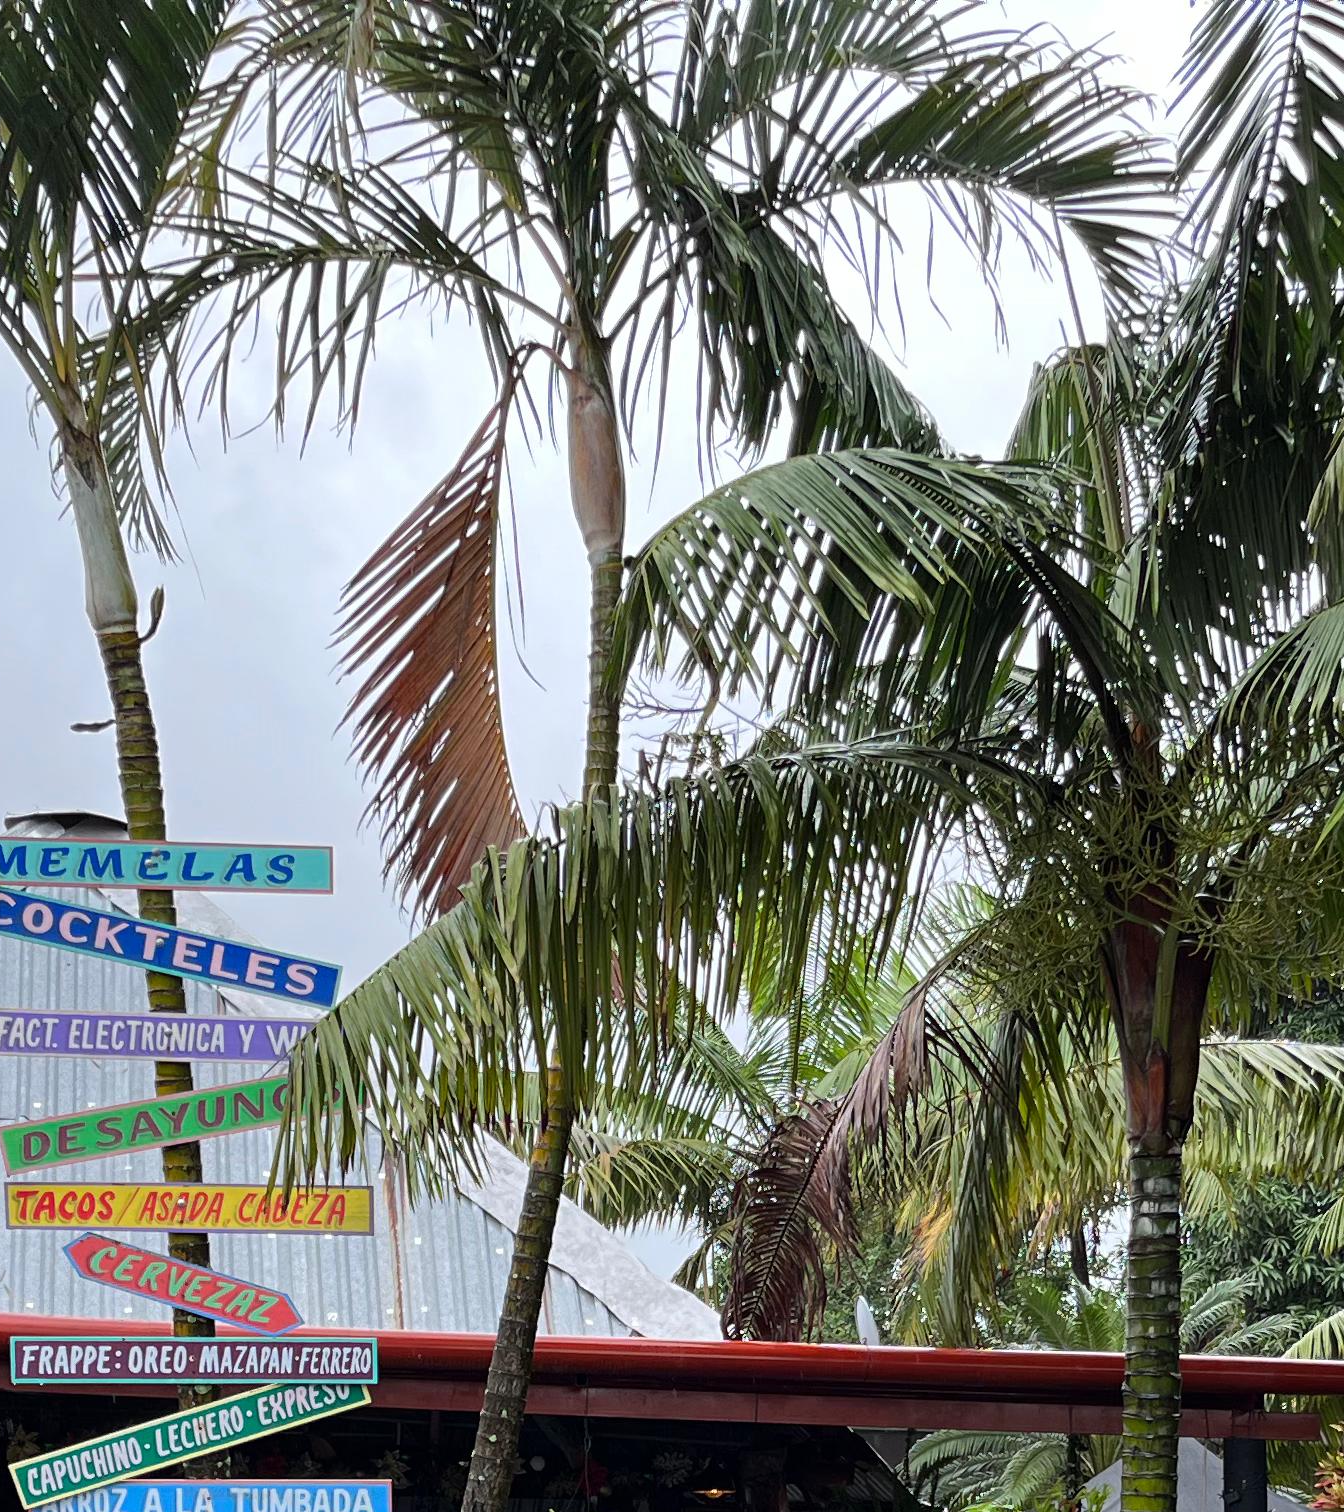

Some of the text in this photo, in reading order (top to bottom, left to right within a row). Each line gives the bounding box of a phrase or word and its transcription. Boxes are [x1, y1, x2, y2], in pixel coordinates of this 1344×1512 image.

[68, 1019, 224, 1053] ELECTRONICA
[239, 1024, 255, 1053] Y
[22, 1083, 341, 1162] DESAYUNO
[239, 1192, 346, 1226] CABEZA
[90, 1246, 281, 1324] CERVEZAZ
[21, 1345, 372, 1375] FRAPPE: OREO MAZAPAN FERRERO
[27, 1437, 143, 1497] CAPUCHINO
[156, 1404, 244, 1457] LECHERO
